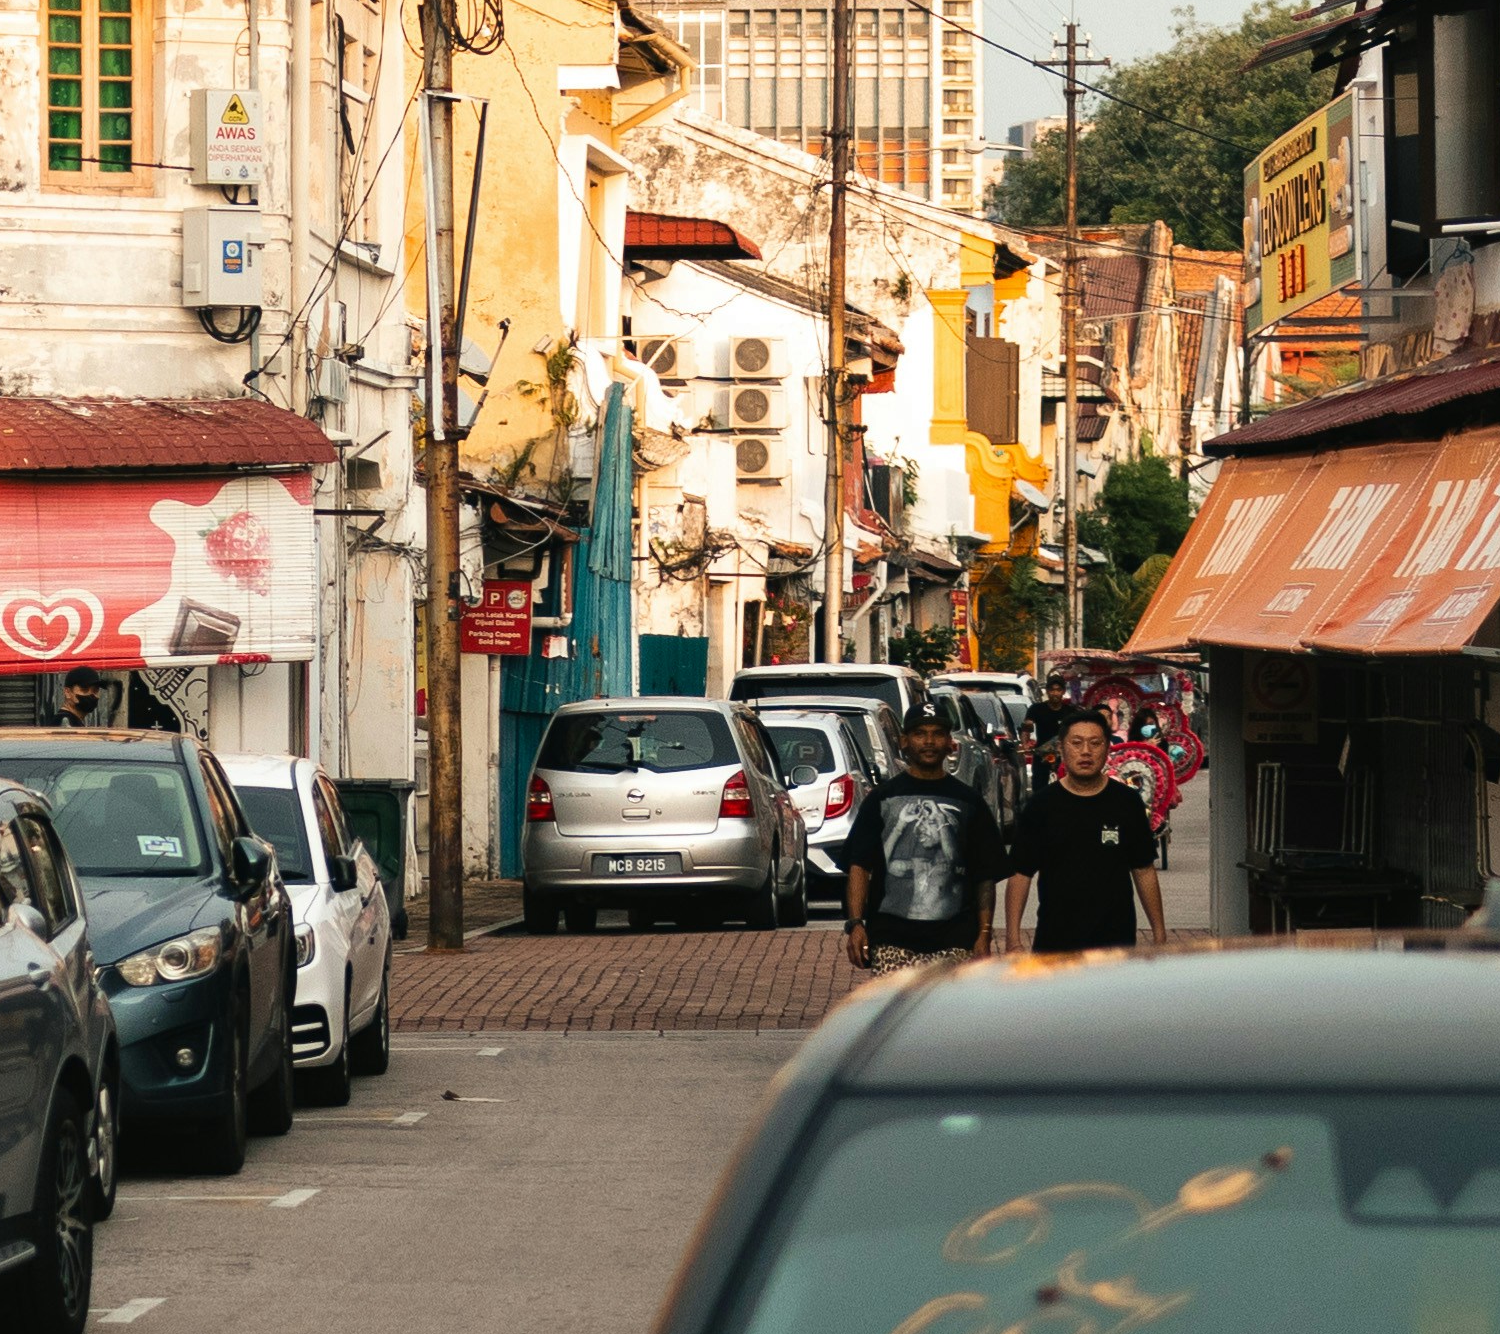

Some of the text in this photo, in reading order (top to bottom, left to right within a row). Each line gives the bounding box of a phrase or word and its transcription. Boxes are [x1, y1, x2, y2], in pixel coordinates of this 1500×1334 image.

[215, 127, 256, 140] AWAS
[208, 154, 263, 163] DIPERHATIKAN
[1289, 482, 1401, 572] TARIK
[1392, 477, 1492, 578] TAR
[490, 592, 501, 605] P
[608, 858, 666, 872] MCB 9215
